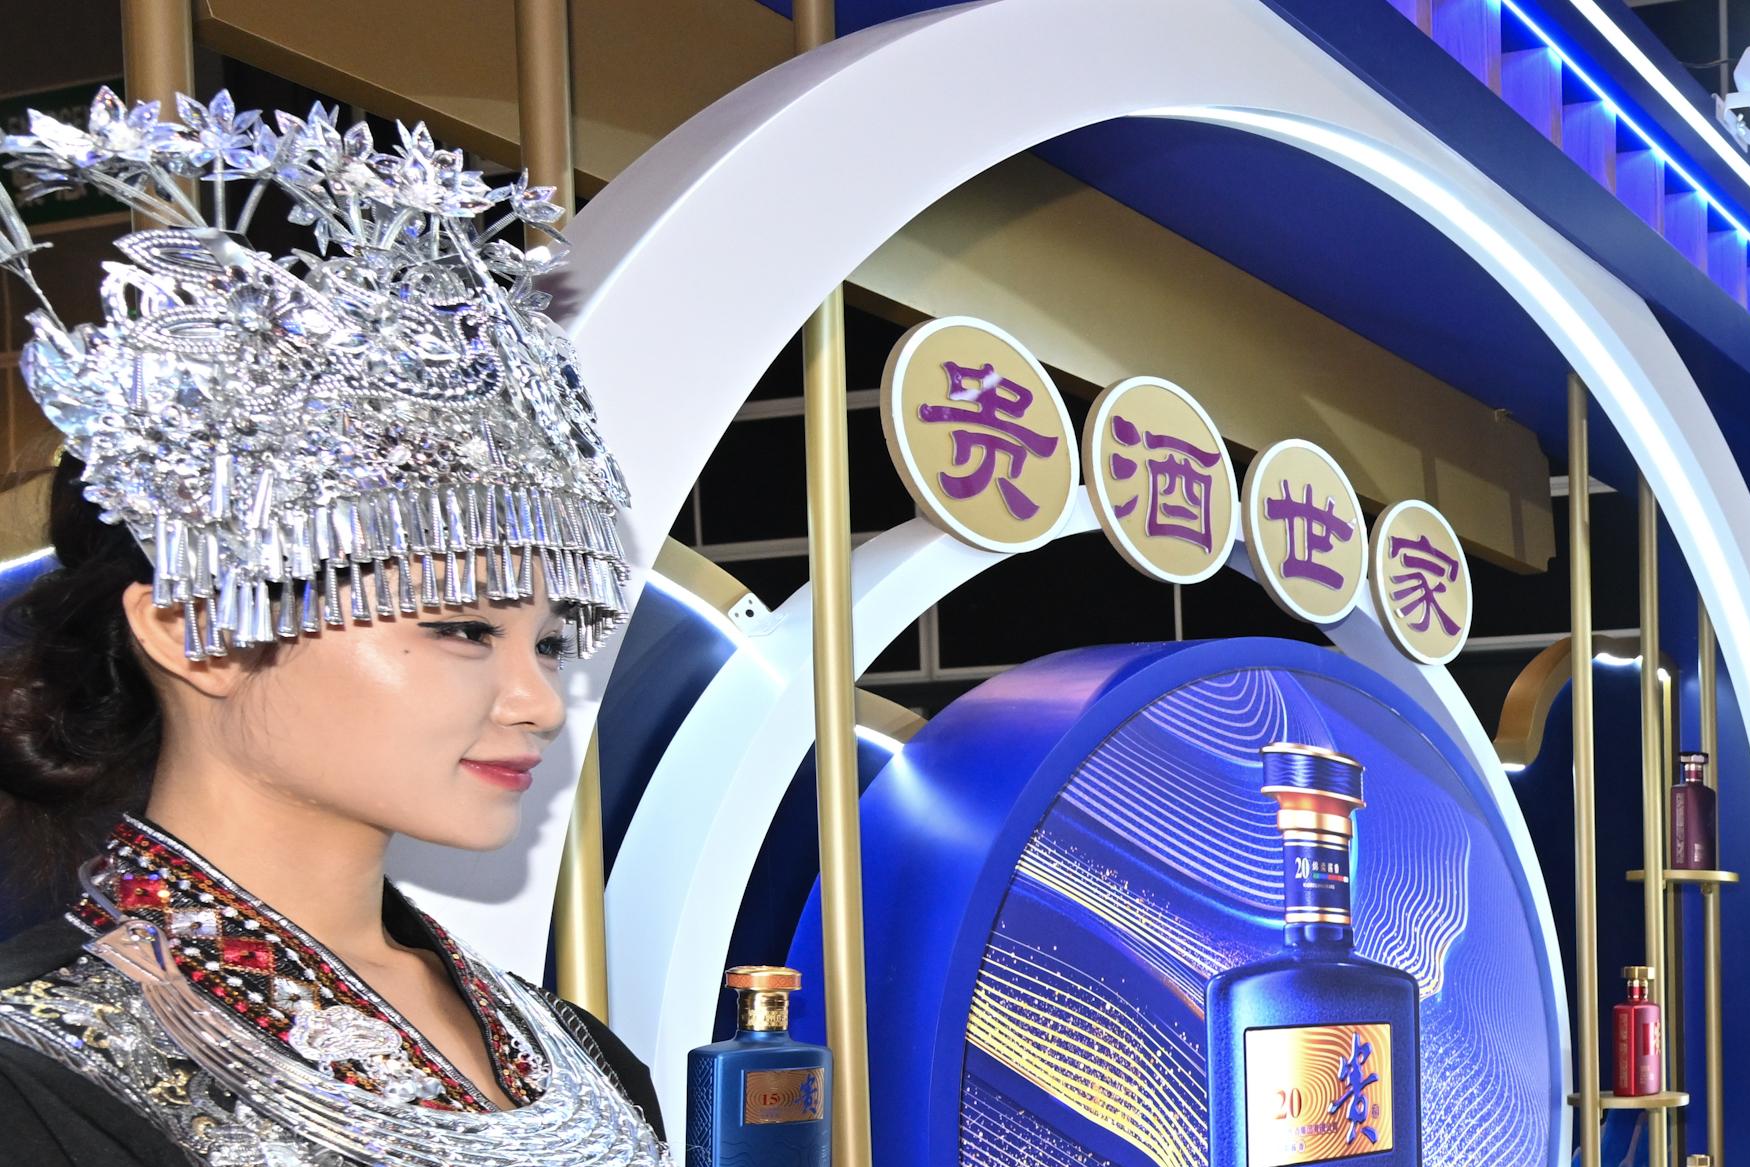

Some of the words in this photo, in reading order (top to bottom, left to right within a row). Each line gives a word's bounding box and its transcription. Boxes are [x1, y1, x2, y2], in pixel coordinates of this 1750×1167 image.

[918, 361, 1462, 638] 贵酒世家
[1295, 857, 1310, 879] 20
[761, 1092, 781, 1106] 15
[1274, 1087, 1302, 1120] 20
